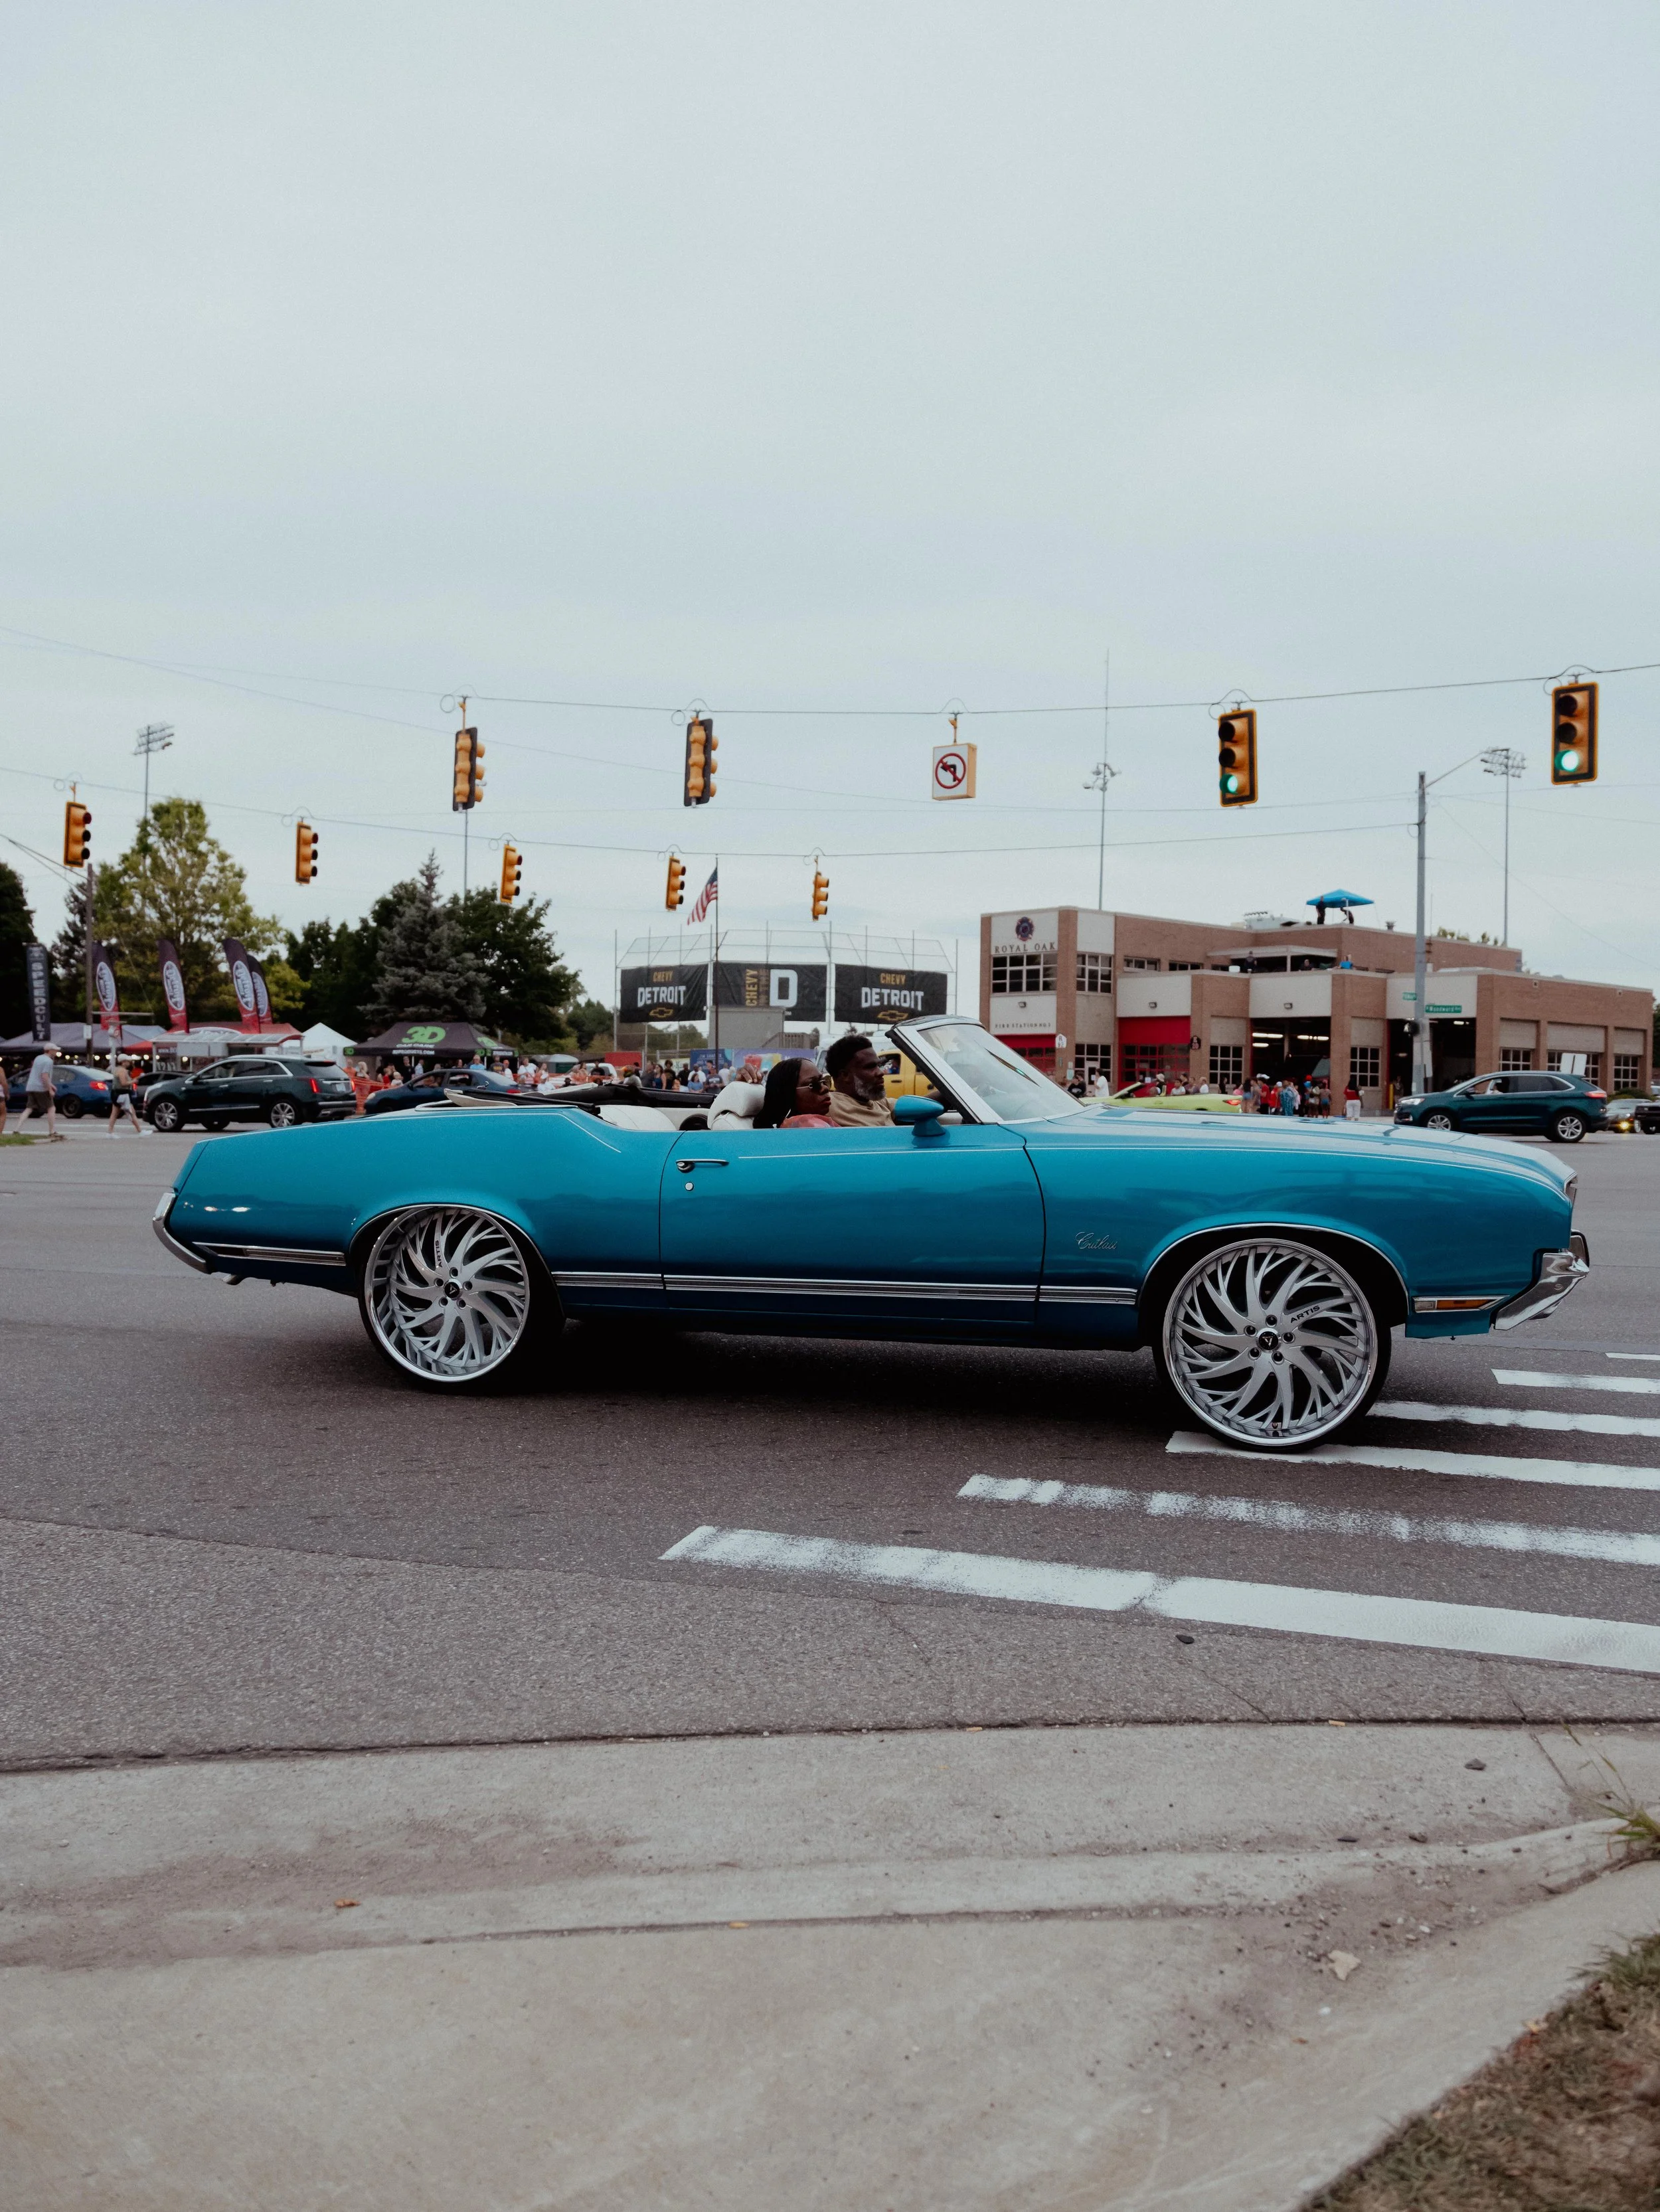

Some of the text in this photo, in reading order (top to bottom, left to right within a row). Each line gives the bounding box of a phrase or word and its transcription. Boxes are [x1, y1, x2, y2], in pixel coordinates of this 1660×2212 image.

[995, 942, 1056, 954] ROYAL OAK
[653, 970, 673, 982] CHEVY
[880, 972, 906, 985] CHEVY
[637, 985, 686, 1007] DETROIT
[746, 969, 758, 1007] CHEVY
[770, 969, 798, 1007] D
[31, 962, 46, 1040] SPEEDCULT
[861, 987, 924, 1011] DETROIT
[402, 1026, 446, 1044] 3D
[1291, 1305, 1320, 1323] ARTIS
